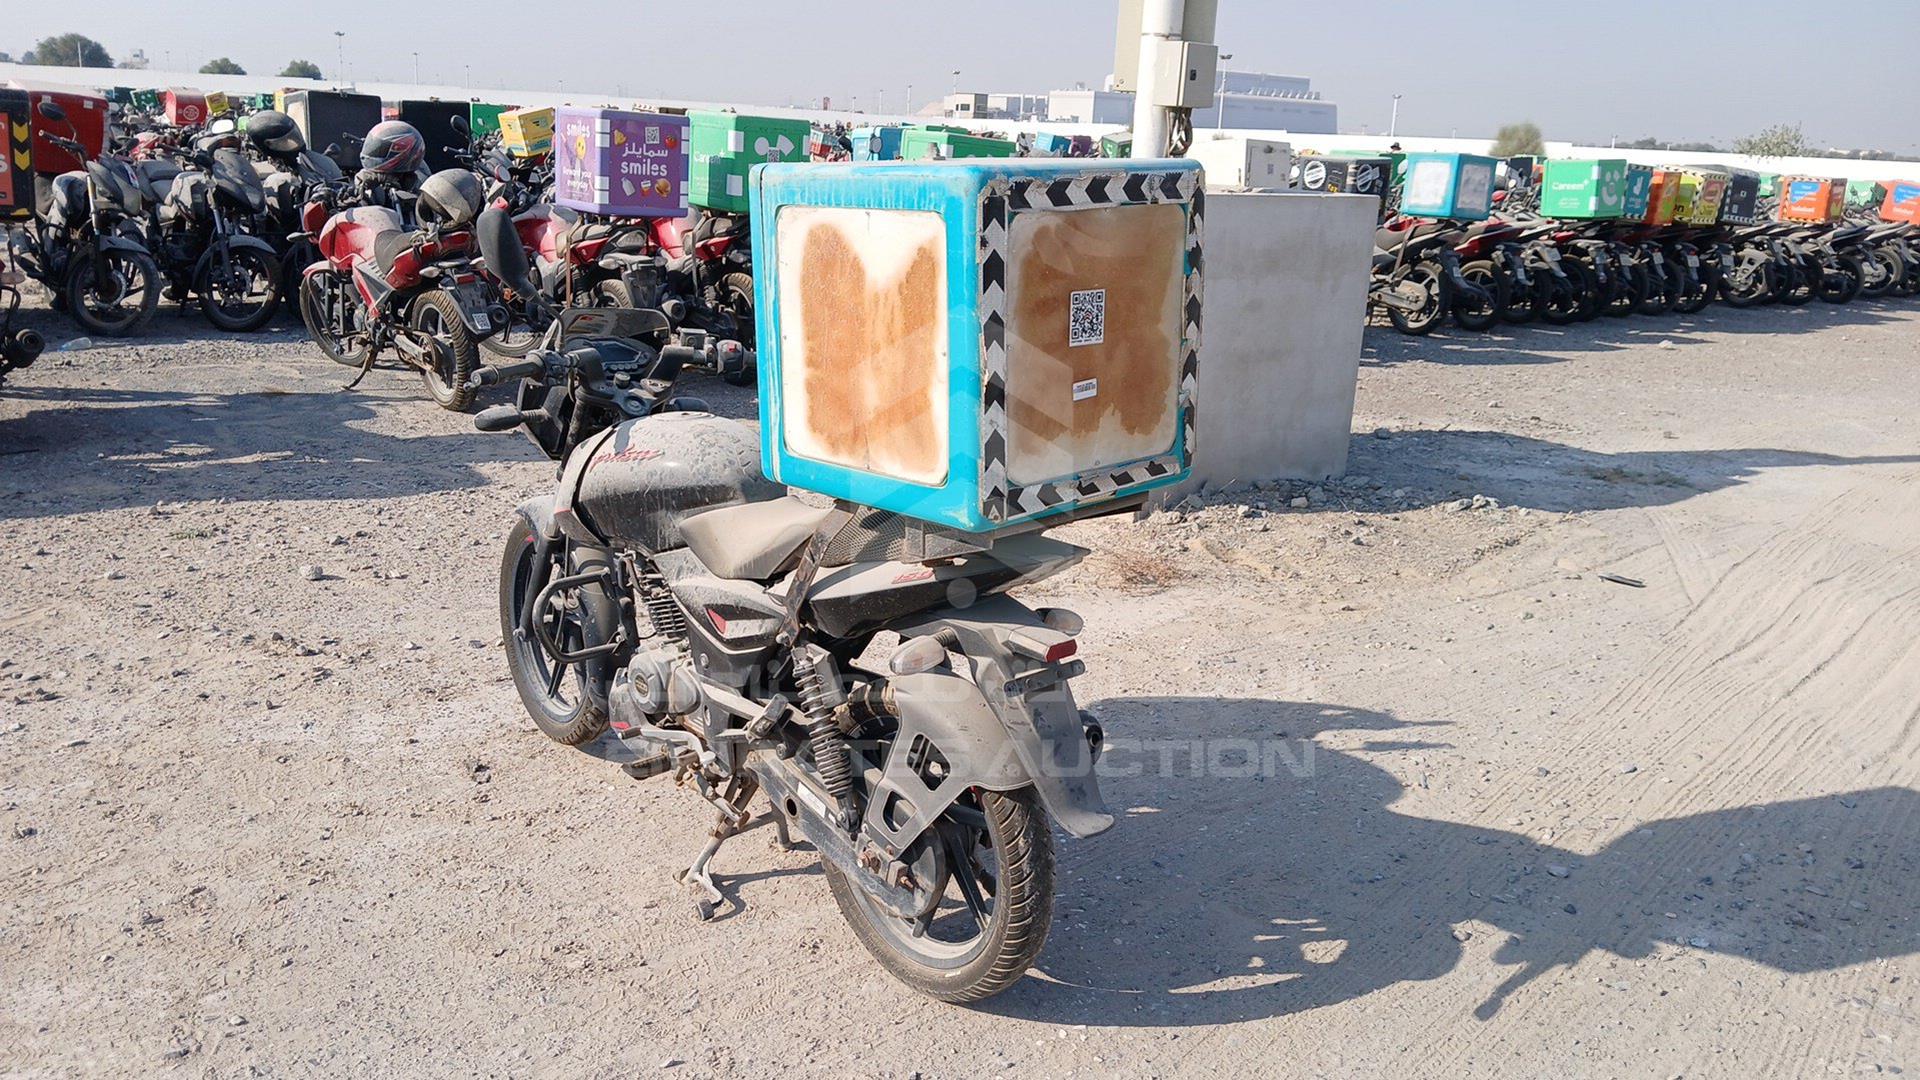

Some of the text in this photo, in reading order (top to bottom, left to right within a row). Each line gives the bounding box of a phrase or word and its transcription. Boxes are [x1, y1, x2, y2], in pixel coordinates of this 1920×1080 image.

[566, 120, 591, 137] smiles
[622, 142, 669, 158] سمايلز
[620, 158, 668, 177] smiles
